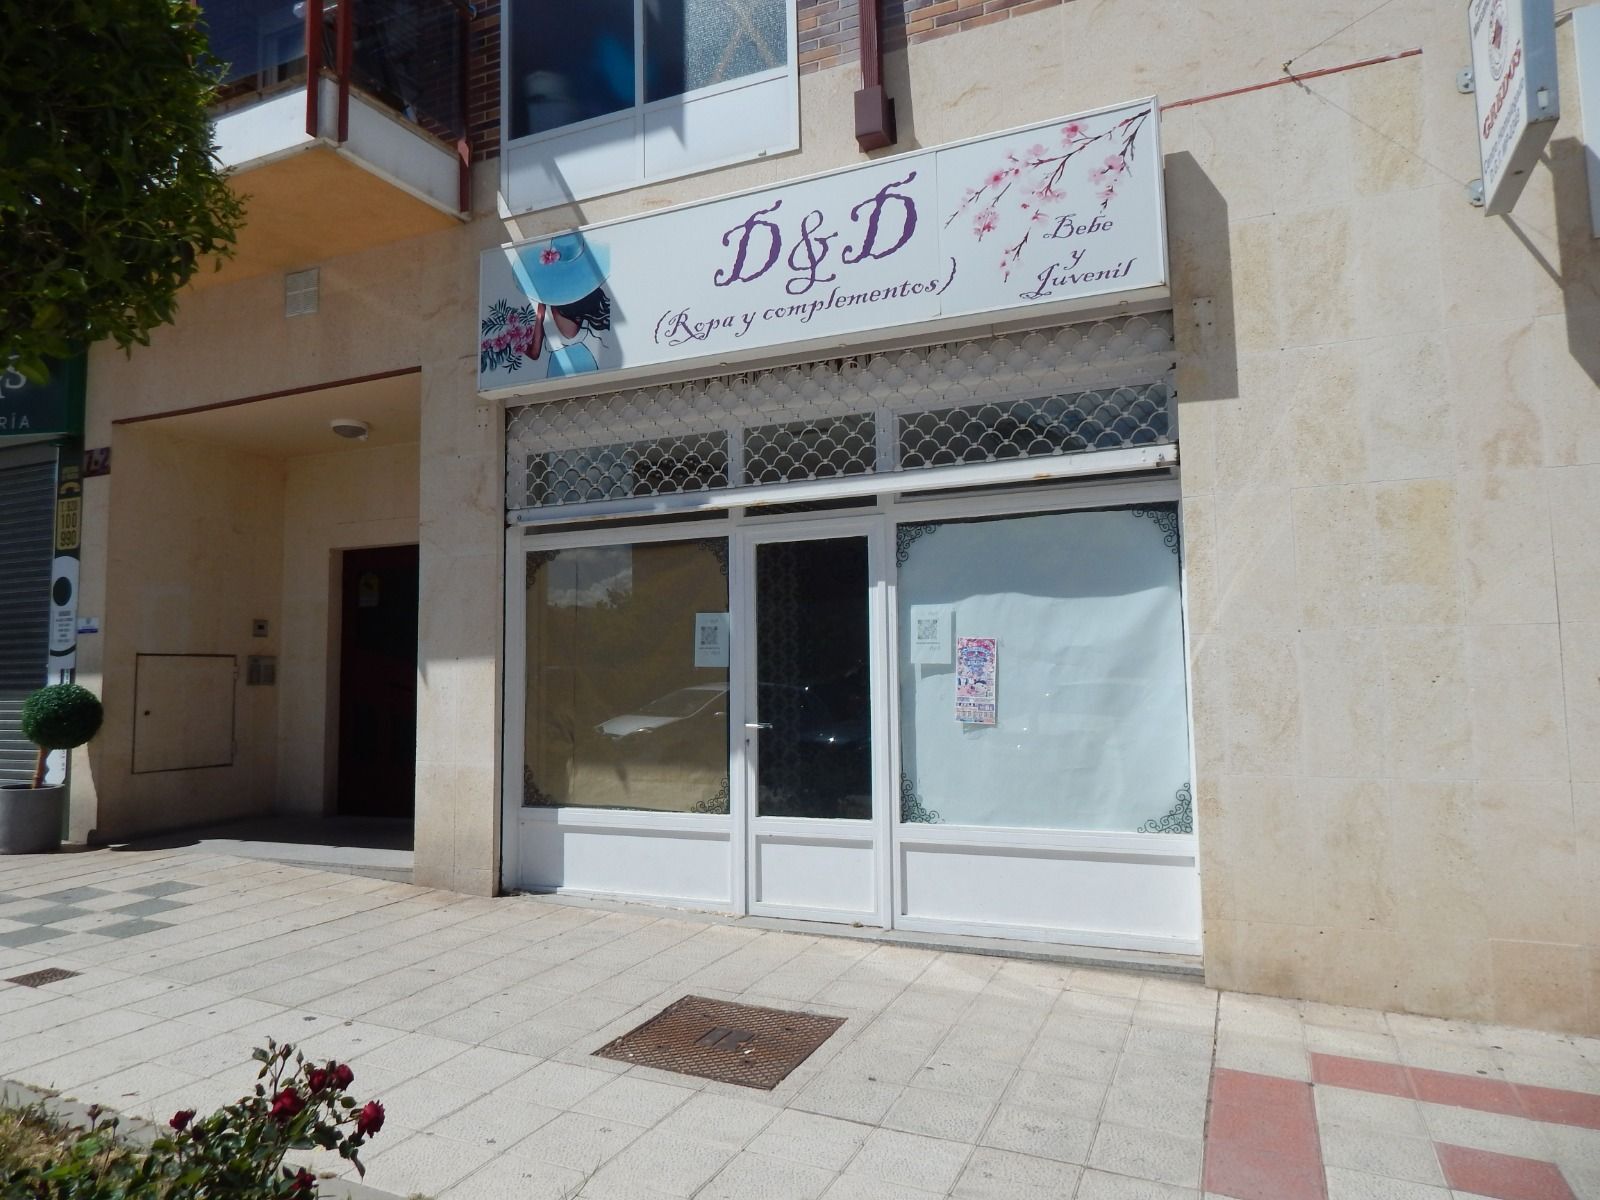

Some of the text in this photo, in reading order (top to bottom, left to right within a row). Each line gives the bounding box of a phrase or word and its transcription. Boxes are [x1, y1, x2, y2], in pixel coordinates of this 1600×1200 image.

[714, 171, 917, 295] D&D
[1064, 249, 1086, 270] y
[654, 256, 957, 347] (Ropa y complementos)
[1019, 257, 1137, 300] Juvenil
